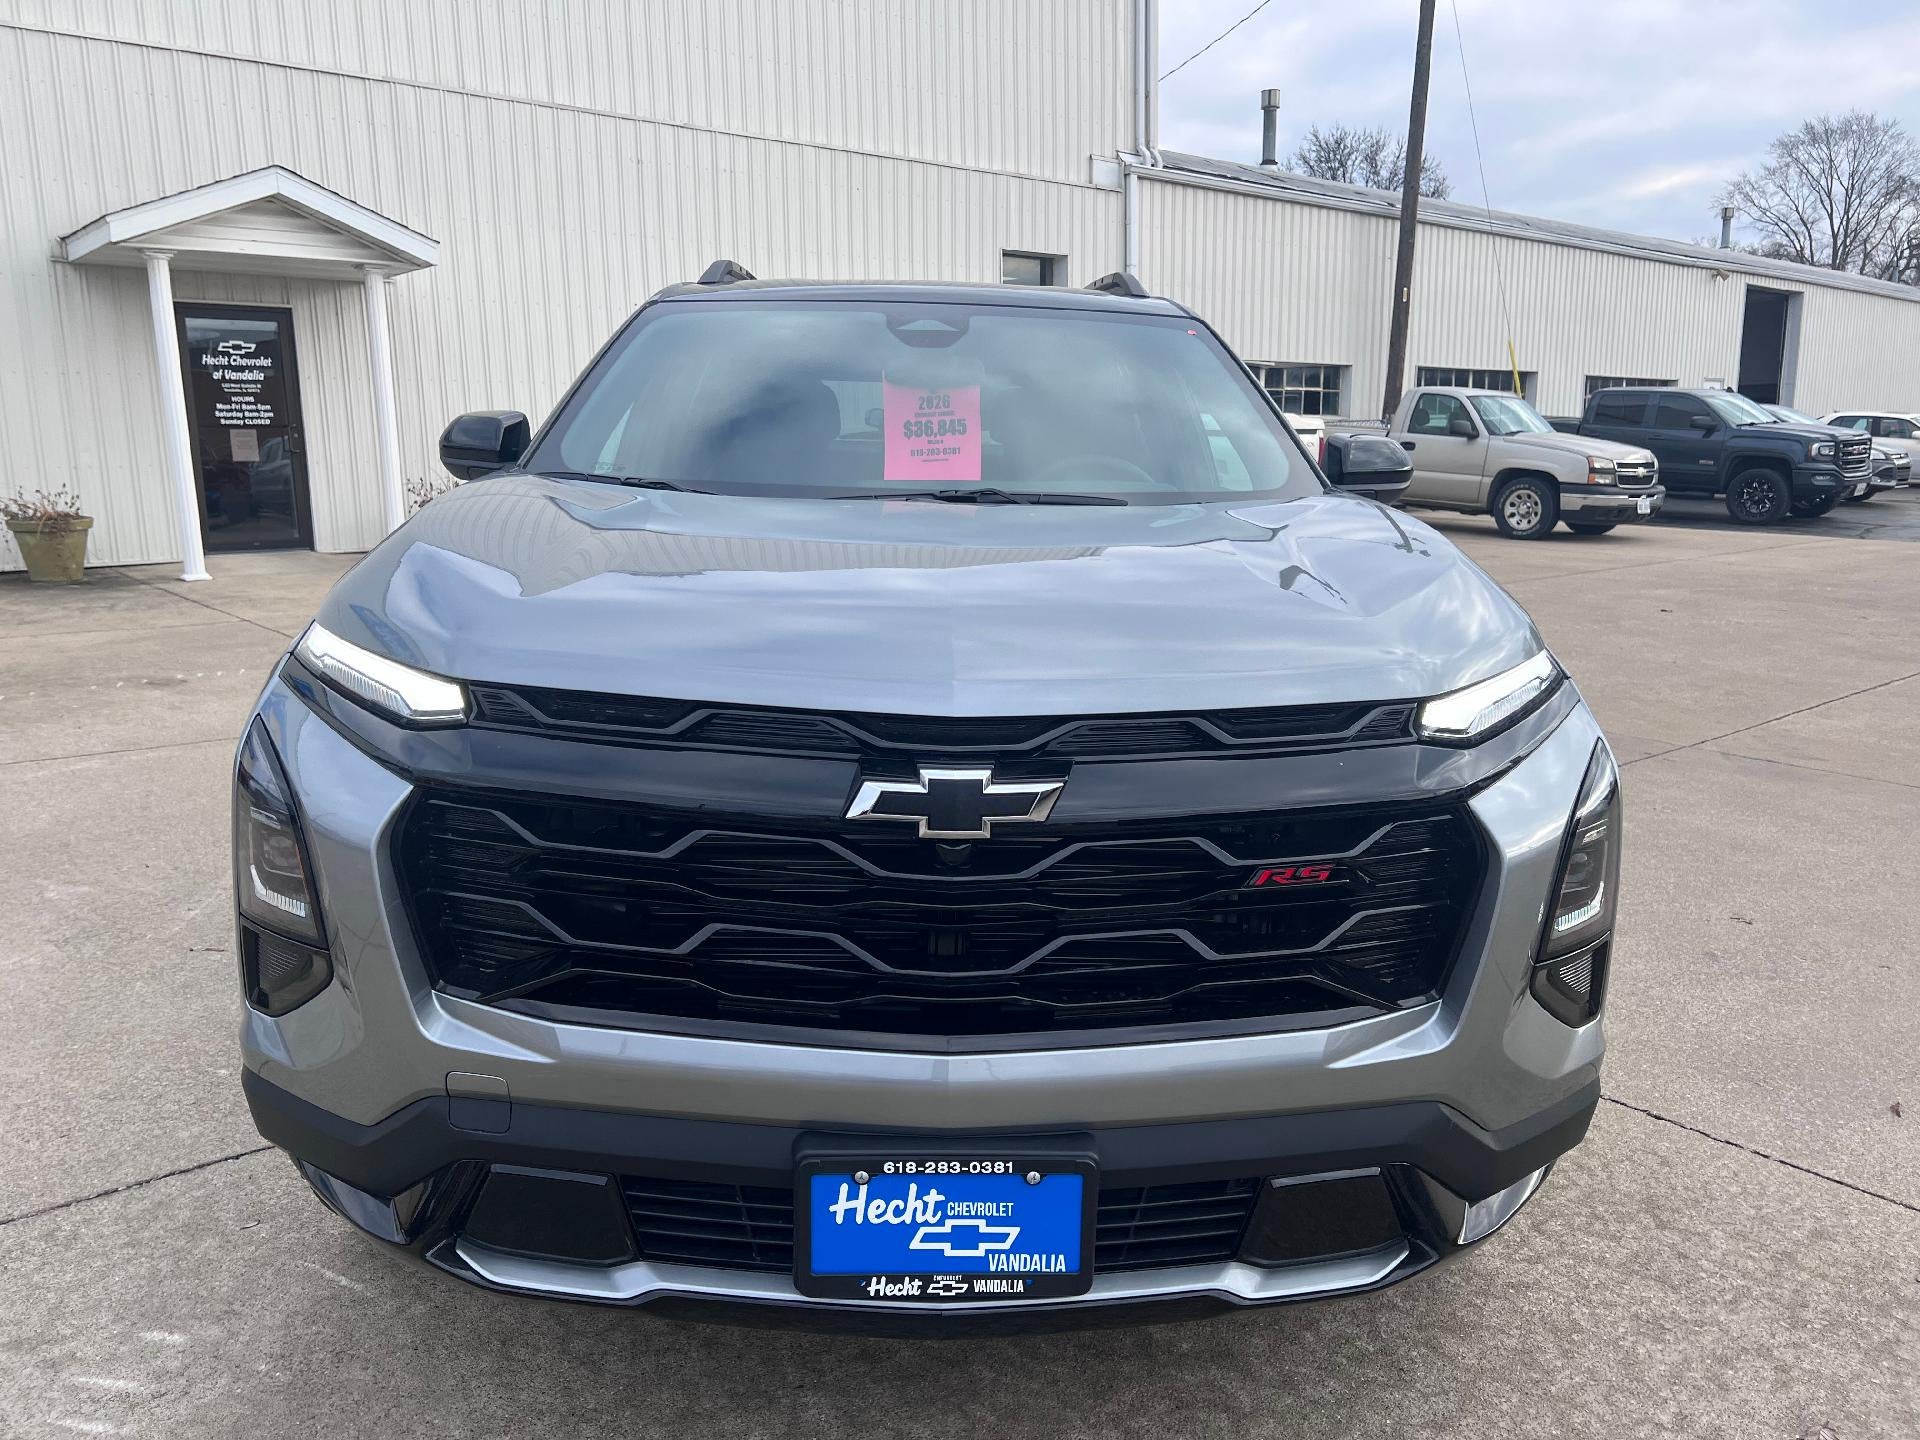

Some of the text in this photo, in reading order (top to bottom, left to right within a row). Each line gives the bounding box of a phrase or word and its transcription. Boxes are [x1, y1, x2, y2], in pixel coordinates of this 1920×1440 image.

[202, 354, 272, 366] Hecht Chevrolet
[212, 369, 265, 381] of Vandalia
[214, 410, 243, 418] Saturday
[220, 418, 244, 426] Sunday
[1248, 864, 1335, 886] RS
[883, 1161, 1014, 1174] 618-283-0381
[828, 1182, 1014, 1225] Hecht CHEVROLET
[988, 1253, 1066, 1273] VANDALIA
[866, 1276, 923, 1297] Hecht
[973, 1279, 1025, 1293] VANDALIA
